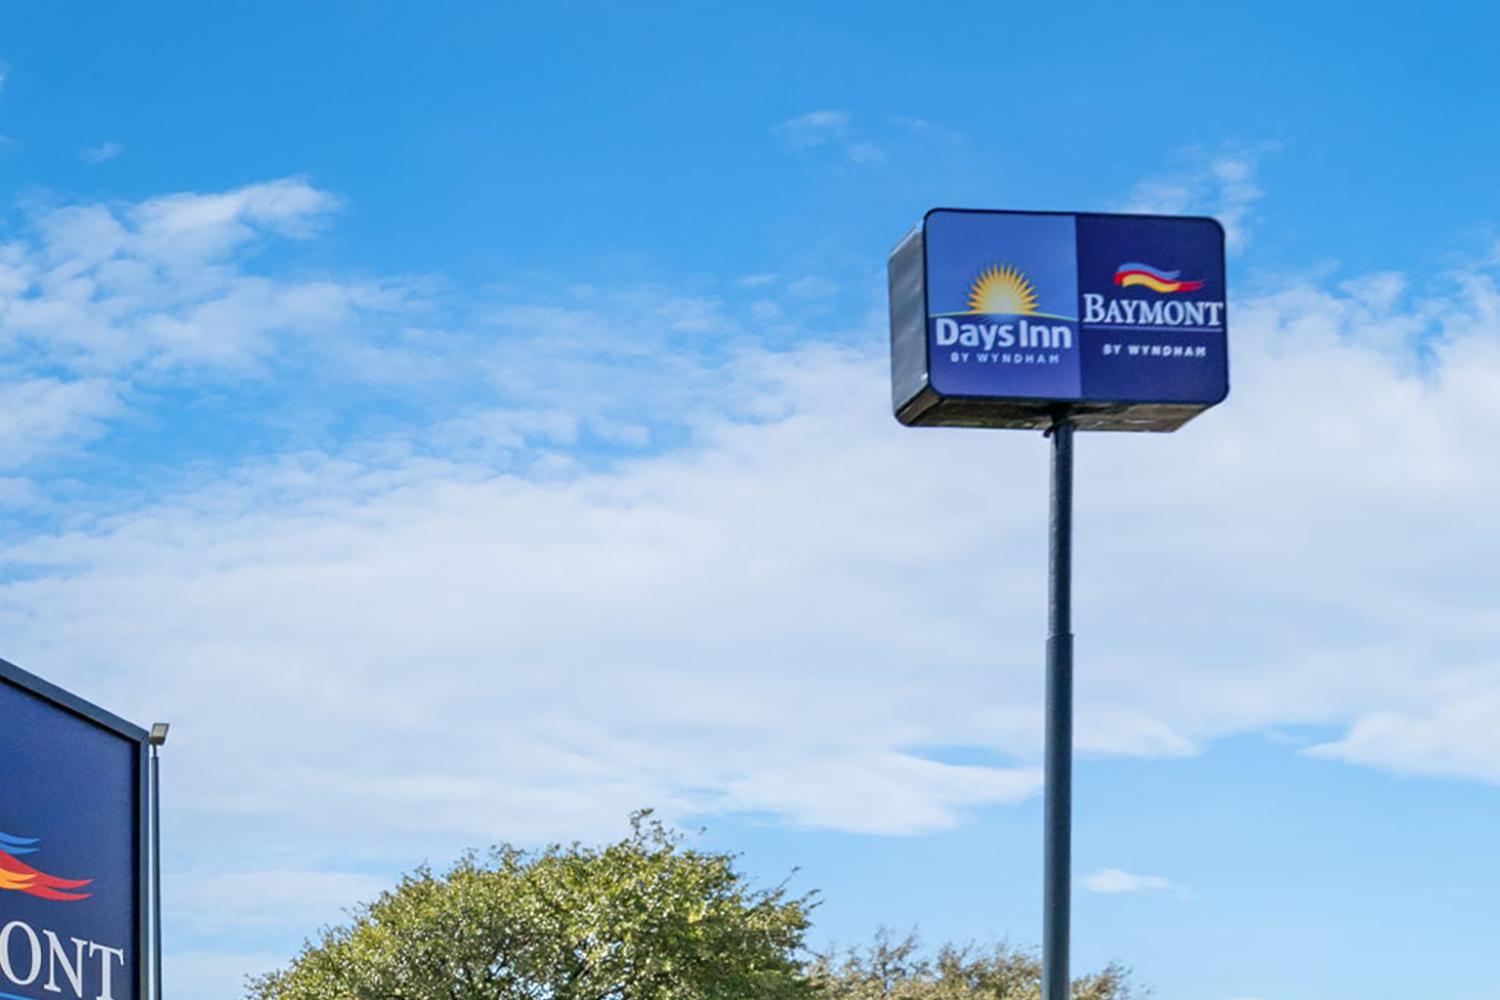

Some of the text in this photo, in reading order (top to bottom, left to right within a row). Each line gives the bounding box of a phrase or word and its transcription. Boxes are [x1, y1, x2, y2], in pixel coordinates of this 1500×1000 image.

[1082, 293, 1223, 327] BAYMONT
[935, 317, 1072, 351] Days Inn
[950, 351, 1060, 364] BY WYNDHAM
[1102, 343, 1207, 357] BY WYNDHAM
